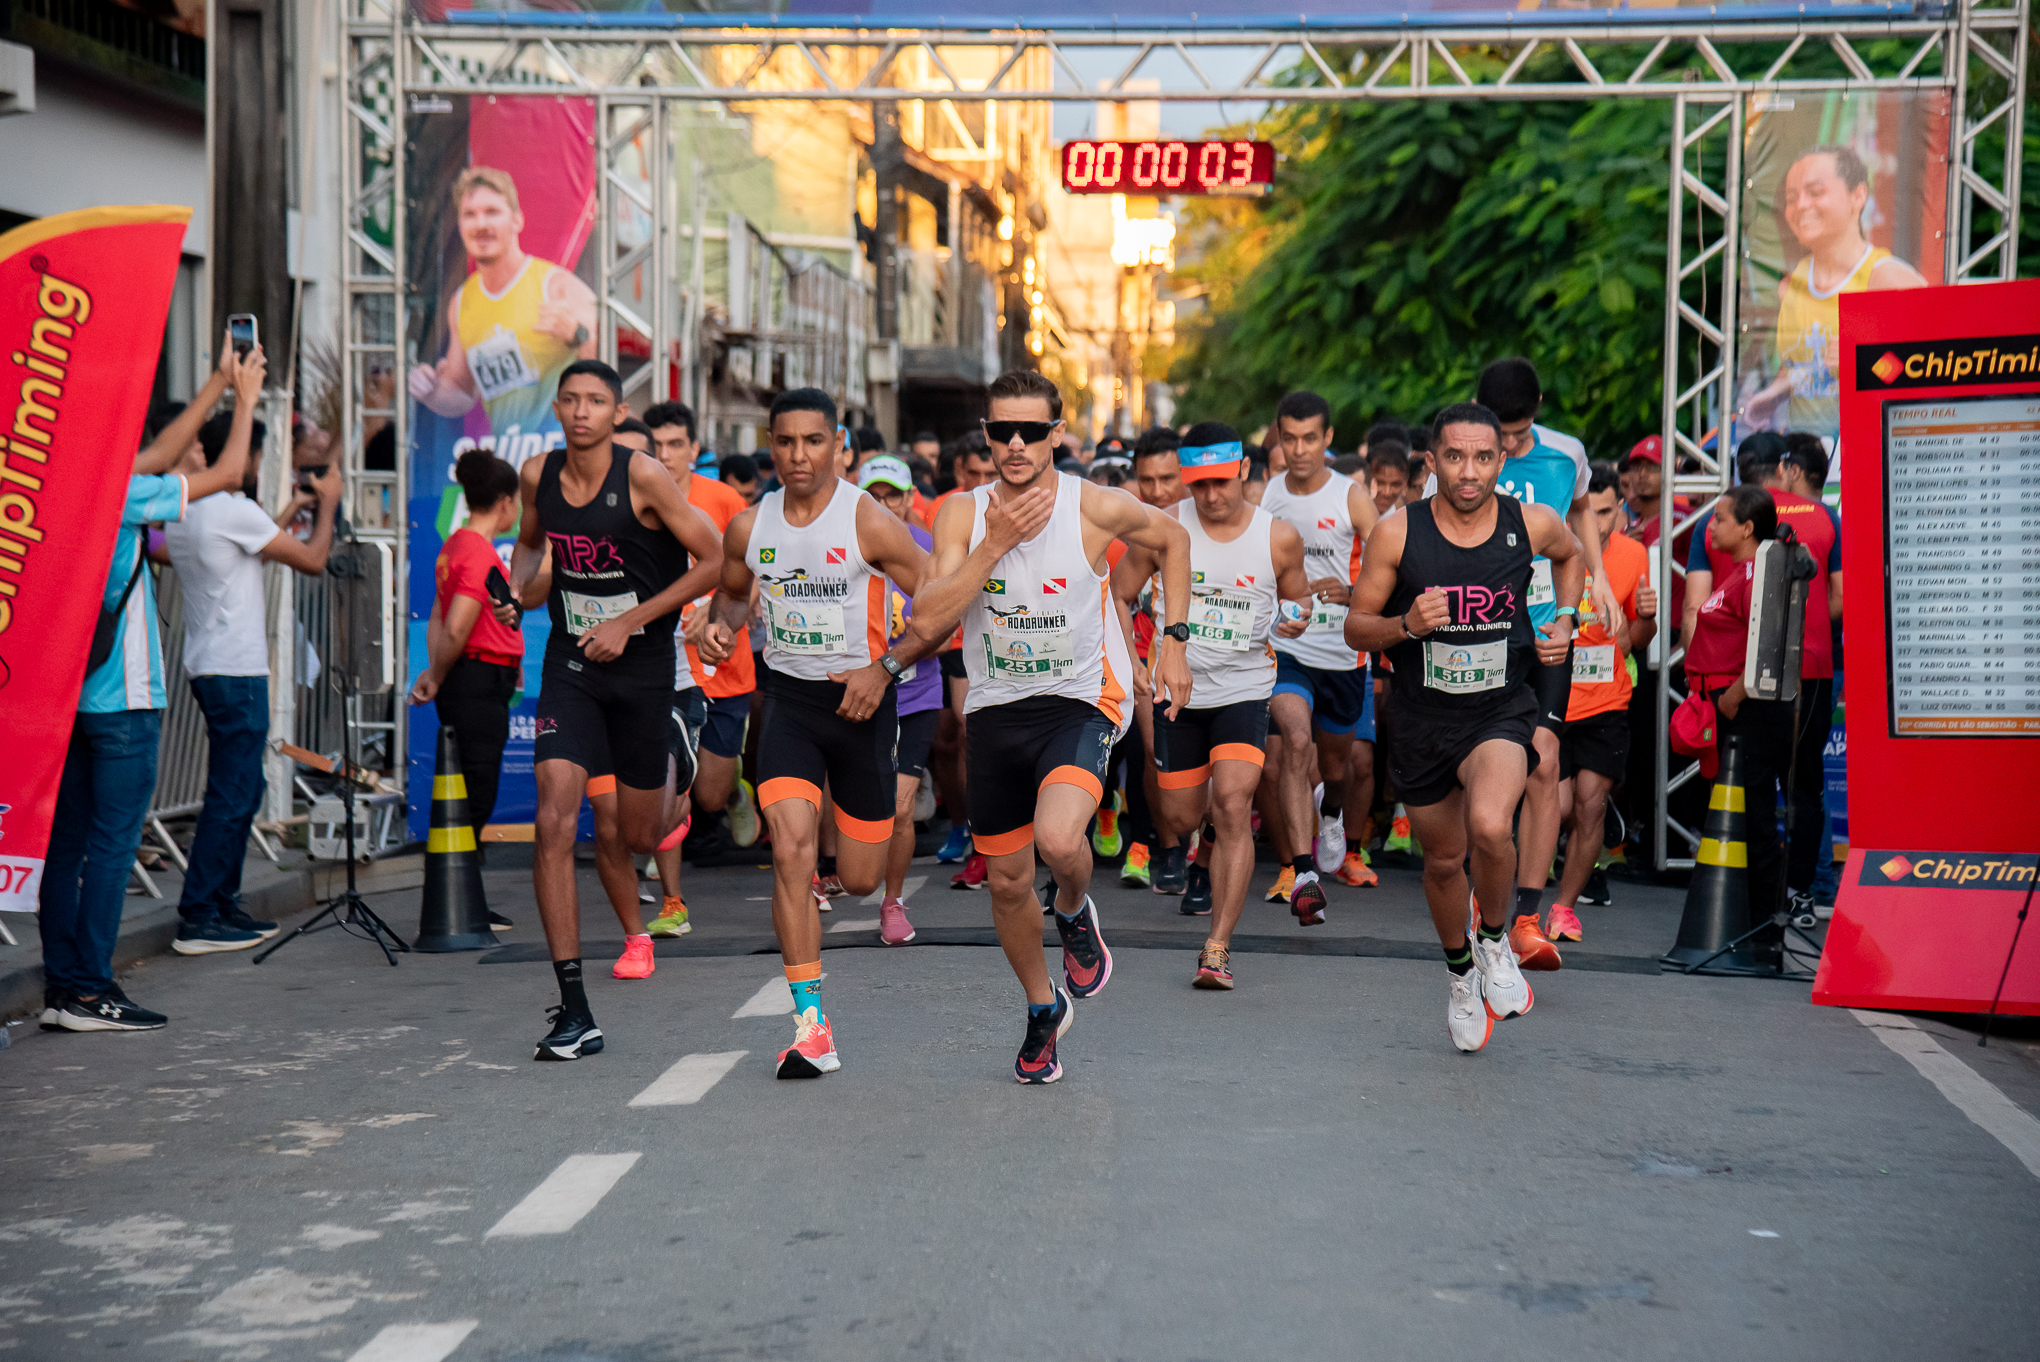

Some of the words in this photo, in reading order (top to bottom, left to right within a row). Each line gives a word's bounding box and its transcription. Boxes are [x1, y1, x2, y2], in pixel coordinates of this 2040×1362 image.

[1066, 142, 1124, 187] 00
[1132, 142, 1188, 187] 00
[1198, 142, 1255, 187] 03
[1892, 409, 1928, 420] TEMPO
[1931, 407, 1957, 419] REAL
[1979, 436, 1987, 444] M
[1915, 452, 1952, 461] ROBSON
[1953, 451, 1965, 459] DA
[1979, 450, 1987, 458] M
[1980, 479, 1987, 487] M
[1980, 492, 1988, 501] M
[1916, 508, 1943, 517] ELTON
[1945, 508, 1957, 516] DA
[1980, 507, 1988, 515] M
[1916, 522, 1938, 530] ALEX
[1980, 520, 1988, 528] M
[1981, 535, 1988, 543] M
[1917, 549, 1965, 558] FRANCISCO
[1981, 549, 1988, 557] M
[1917, 563, 1962, 572] RAIMUNDO
[1981, 563, 1989, 571] M
[1917, 578, 1946, 586] EDVAN
[1982, 577, 1989, 585] M
[784, 583, 848, 598] ROADRUNNER
[1982, 591, 1989, 599] M
[1204, 597, 1250, 611] ROADRUNNER
[1982, 605, 1988, 613] F
[581, 616, 607, 629] 52
[1008, 615, 1066, 630] ROADRUNNER
[1476, 622, 1512, 632] RUNNERS
[1983, 619, 1990, 627] M
[1196, 626, 1225, 640] 166
[1983, 633, 1989, 641] F
[782, 631, 811, 645] 471
[823, 634, 844, 642] 7km
[1919, 647, 1954, 655] PATRICK
[1983, 647, 1991, 655] M
[1004, 660, 1038, 672] 251
[1050, 659, 1072, 668] 7km
[1984, 661, 1991, 669] M
[1442, 670, 1476, 682] 518
[1920, 689, 1960, 697] WALLACE
[1984, 689, 1992, 697] M
[1921, 703, 1939, 711] LUIZ
[1941, 703, 1972, 711] OTAVIO
[1985, 703, 1992, 711] M
[1960, 720, 1975, 729] SÃO
[1977, 720, 2017, 729] SEBASTIÃO
[1912, 859, 2040, 884] ChipTim
